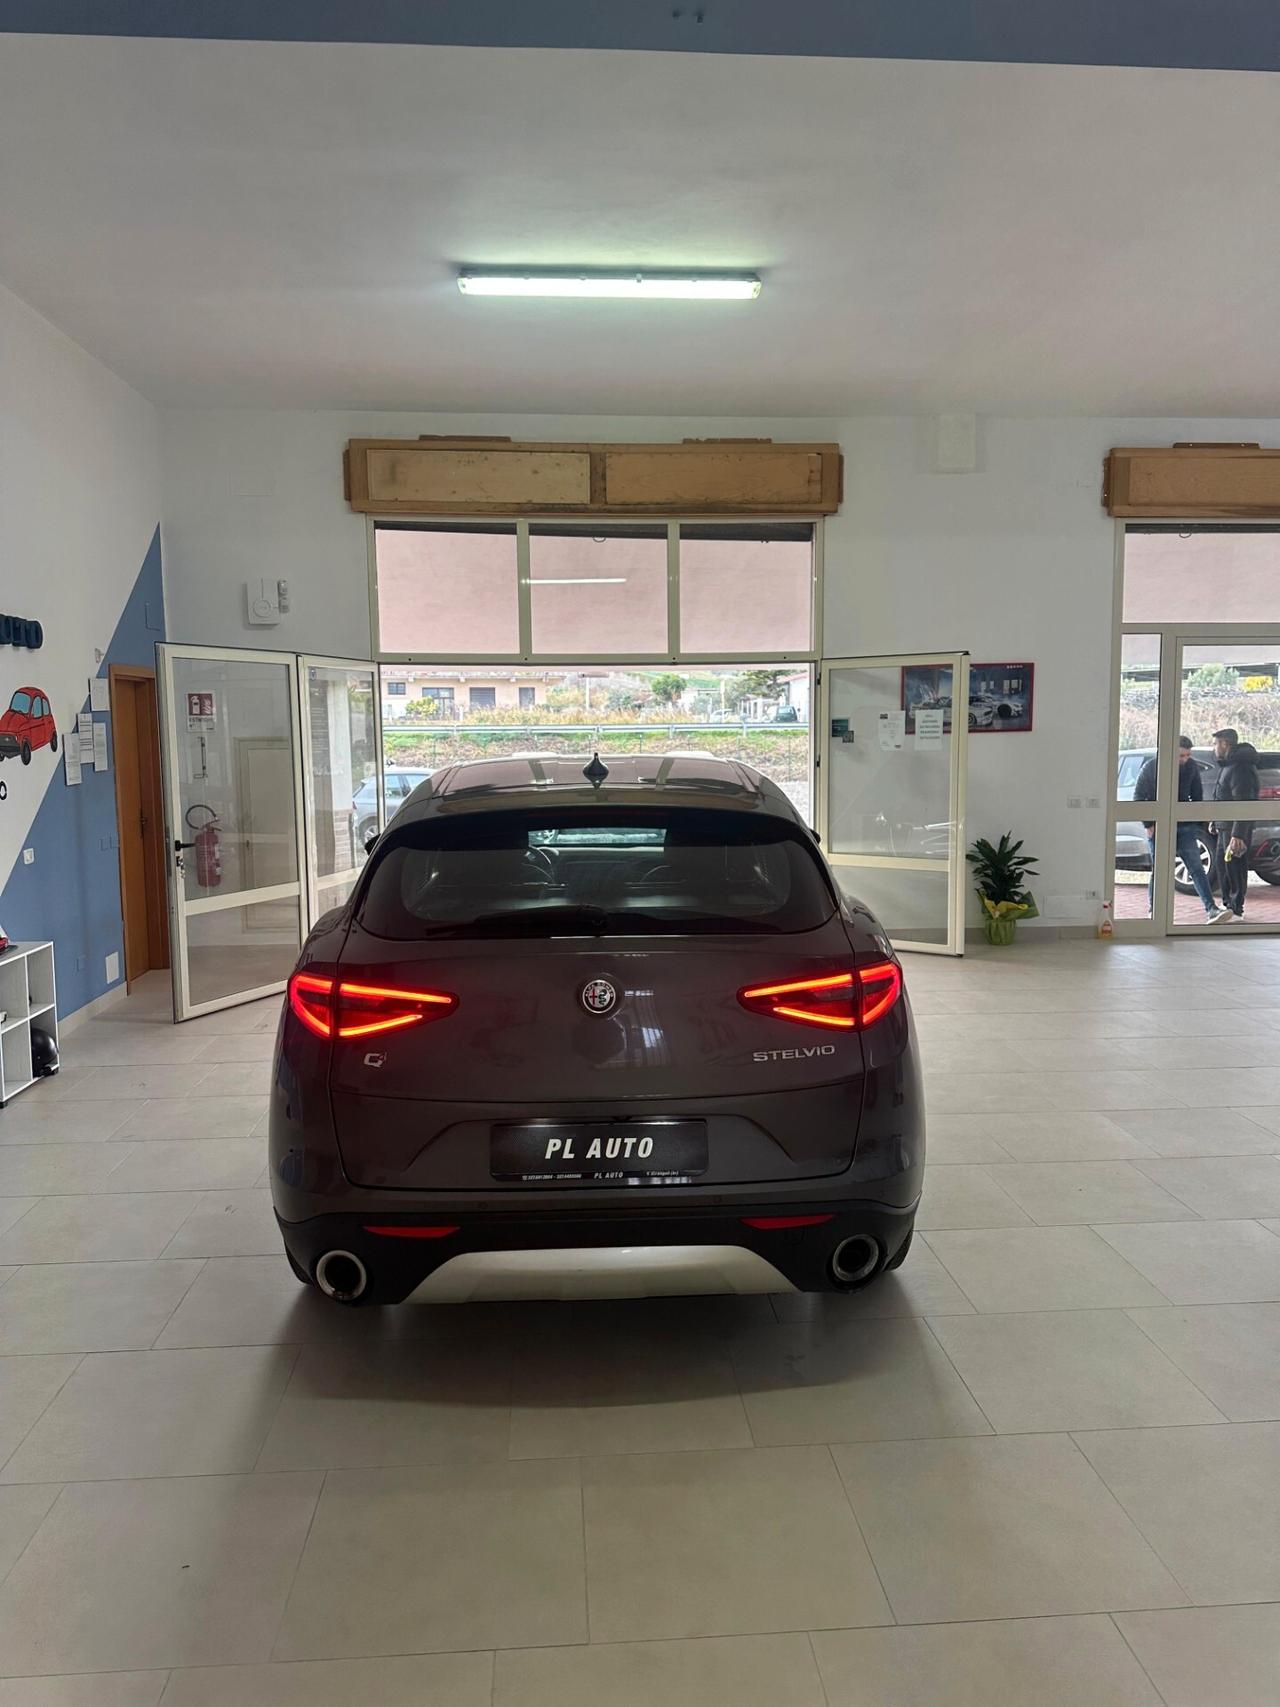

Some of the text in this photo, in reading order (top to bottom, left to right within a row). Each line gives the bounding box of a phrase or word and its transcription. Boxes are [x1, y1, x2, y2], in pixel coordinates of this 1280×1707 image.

[752, 1045, 835, 1062] STELVIO
[545, 1137, 654, 1159] PL AUTO
[604, 1171, 624, 1179] AUTO
